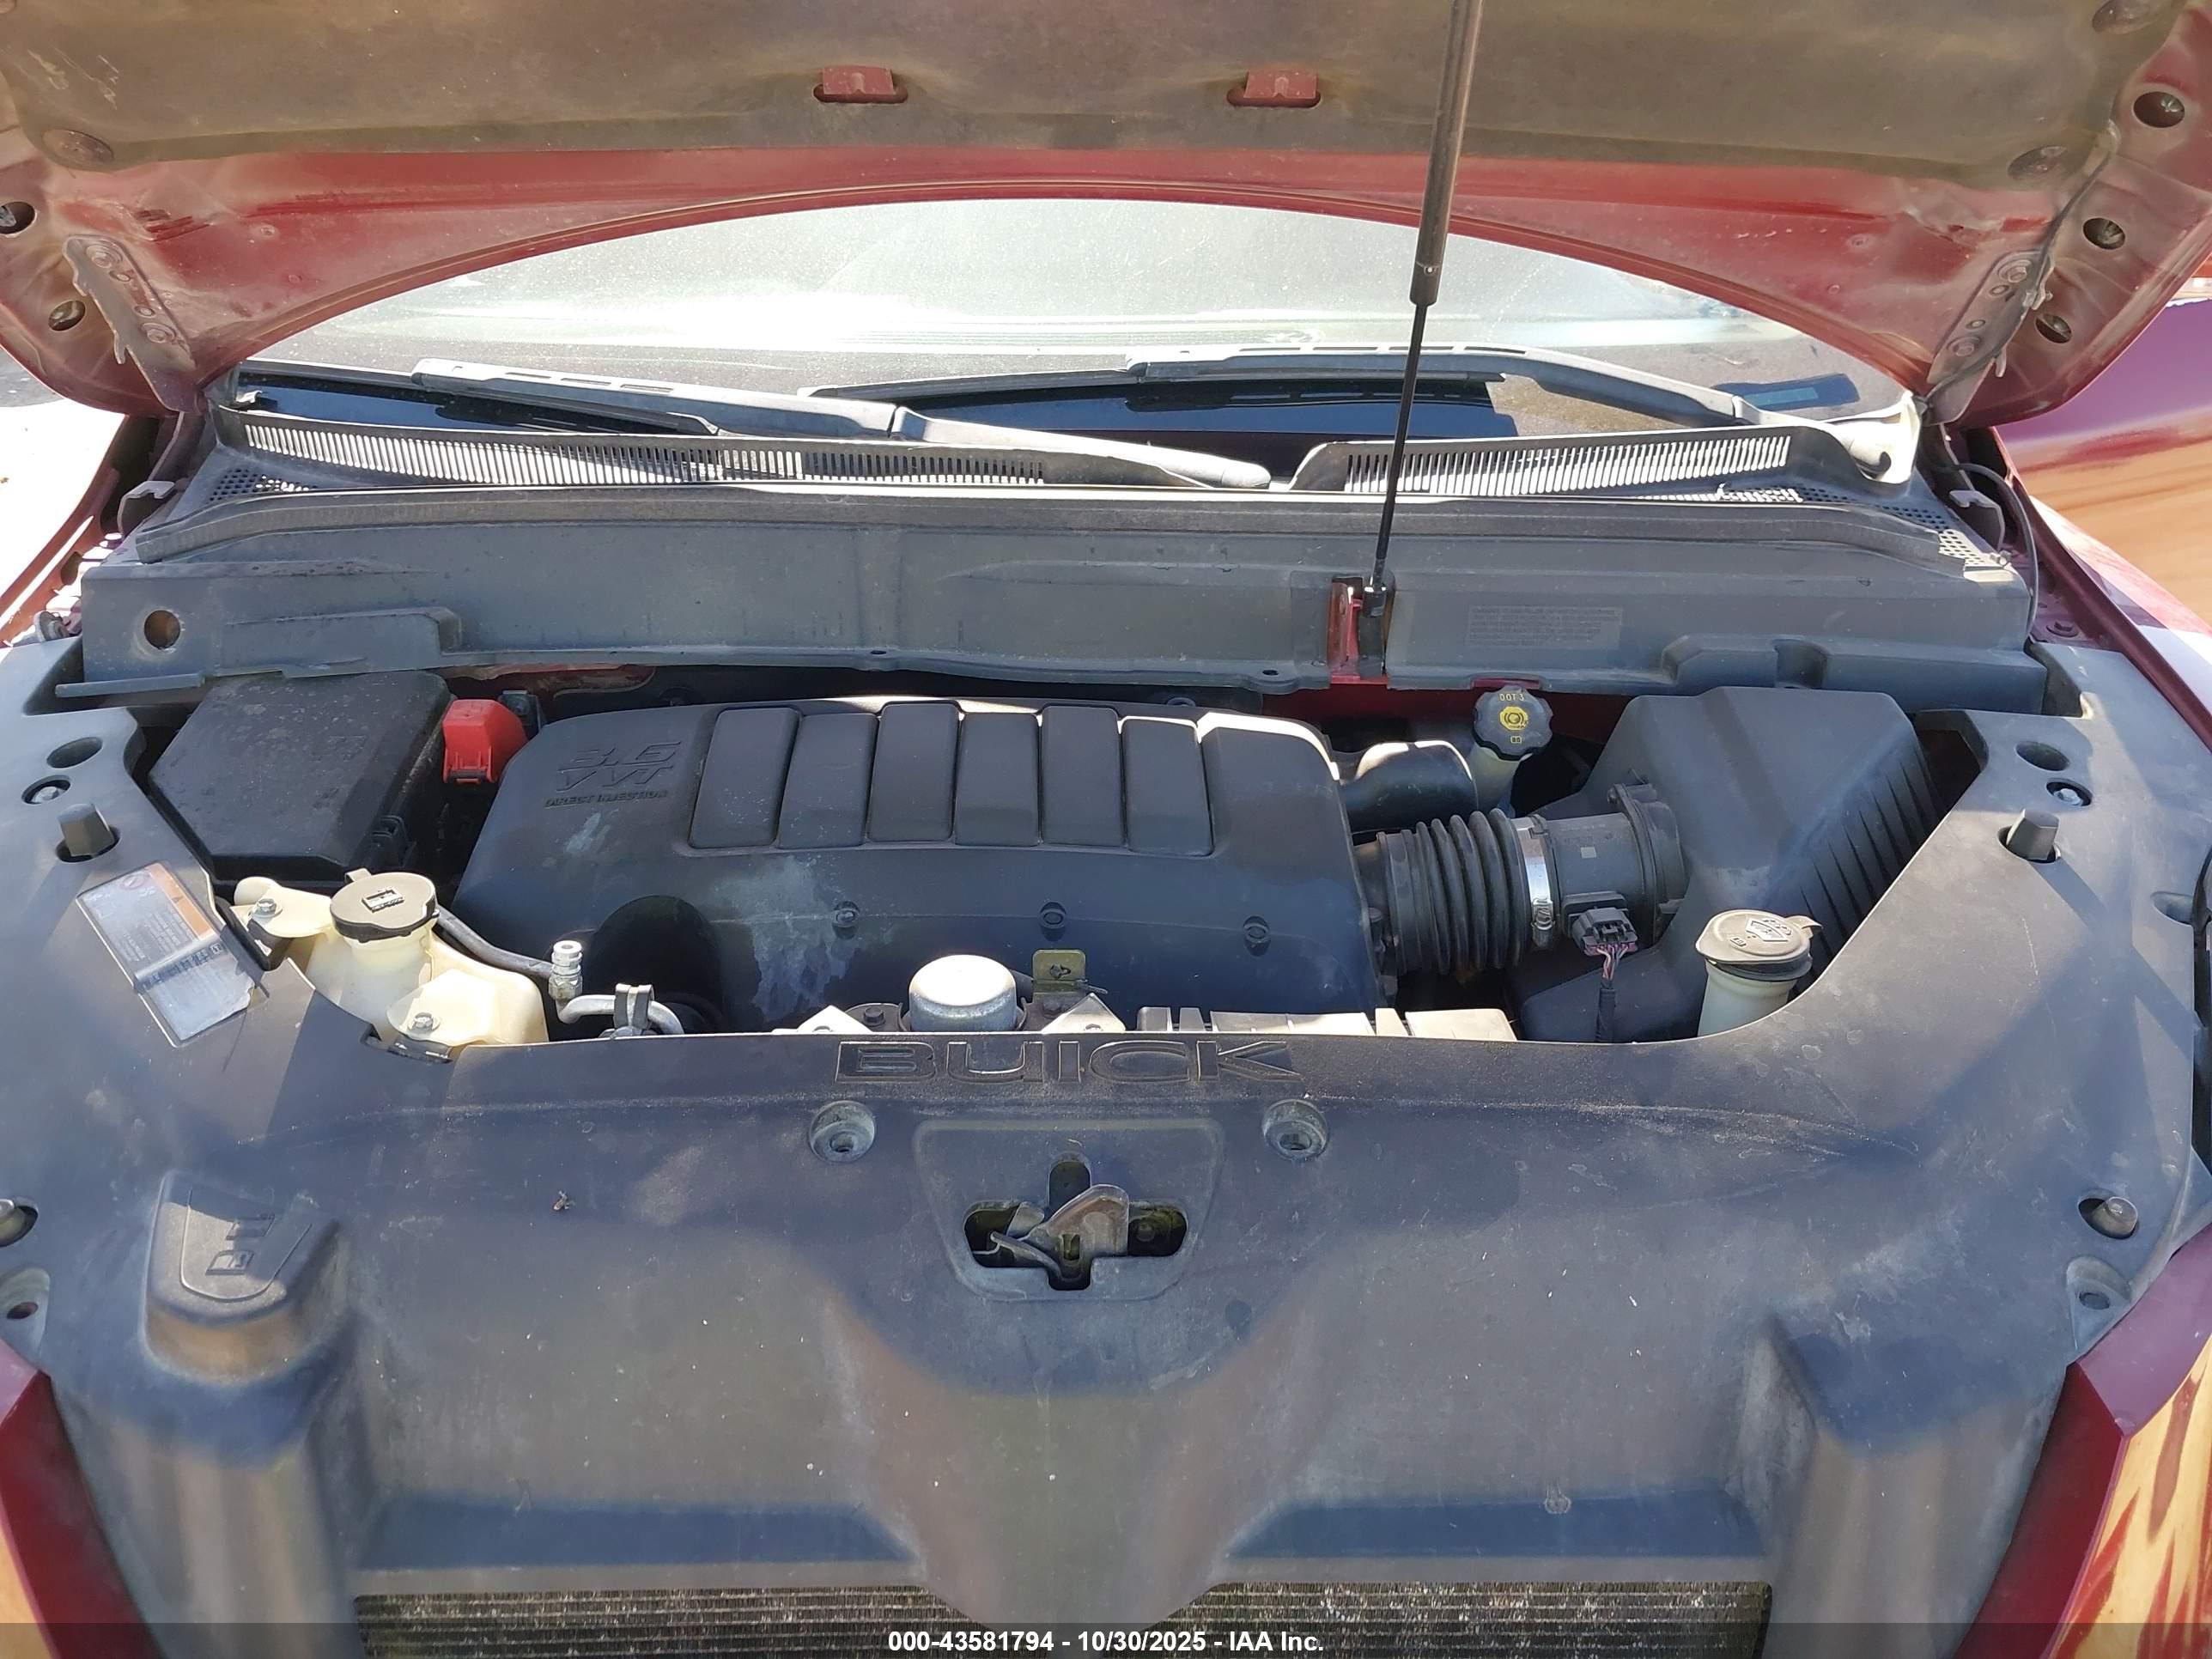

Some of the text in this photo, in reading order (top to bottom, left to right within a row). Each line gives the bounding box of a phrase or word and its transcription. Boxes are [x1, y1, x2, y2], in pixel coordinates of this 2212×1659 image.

[1498, 693, 1525, 702] DOT 3
[556, 765, 674, 793] VVT
[834, 1040, 1303, 1084] BUICK
